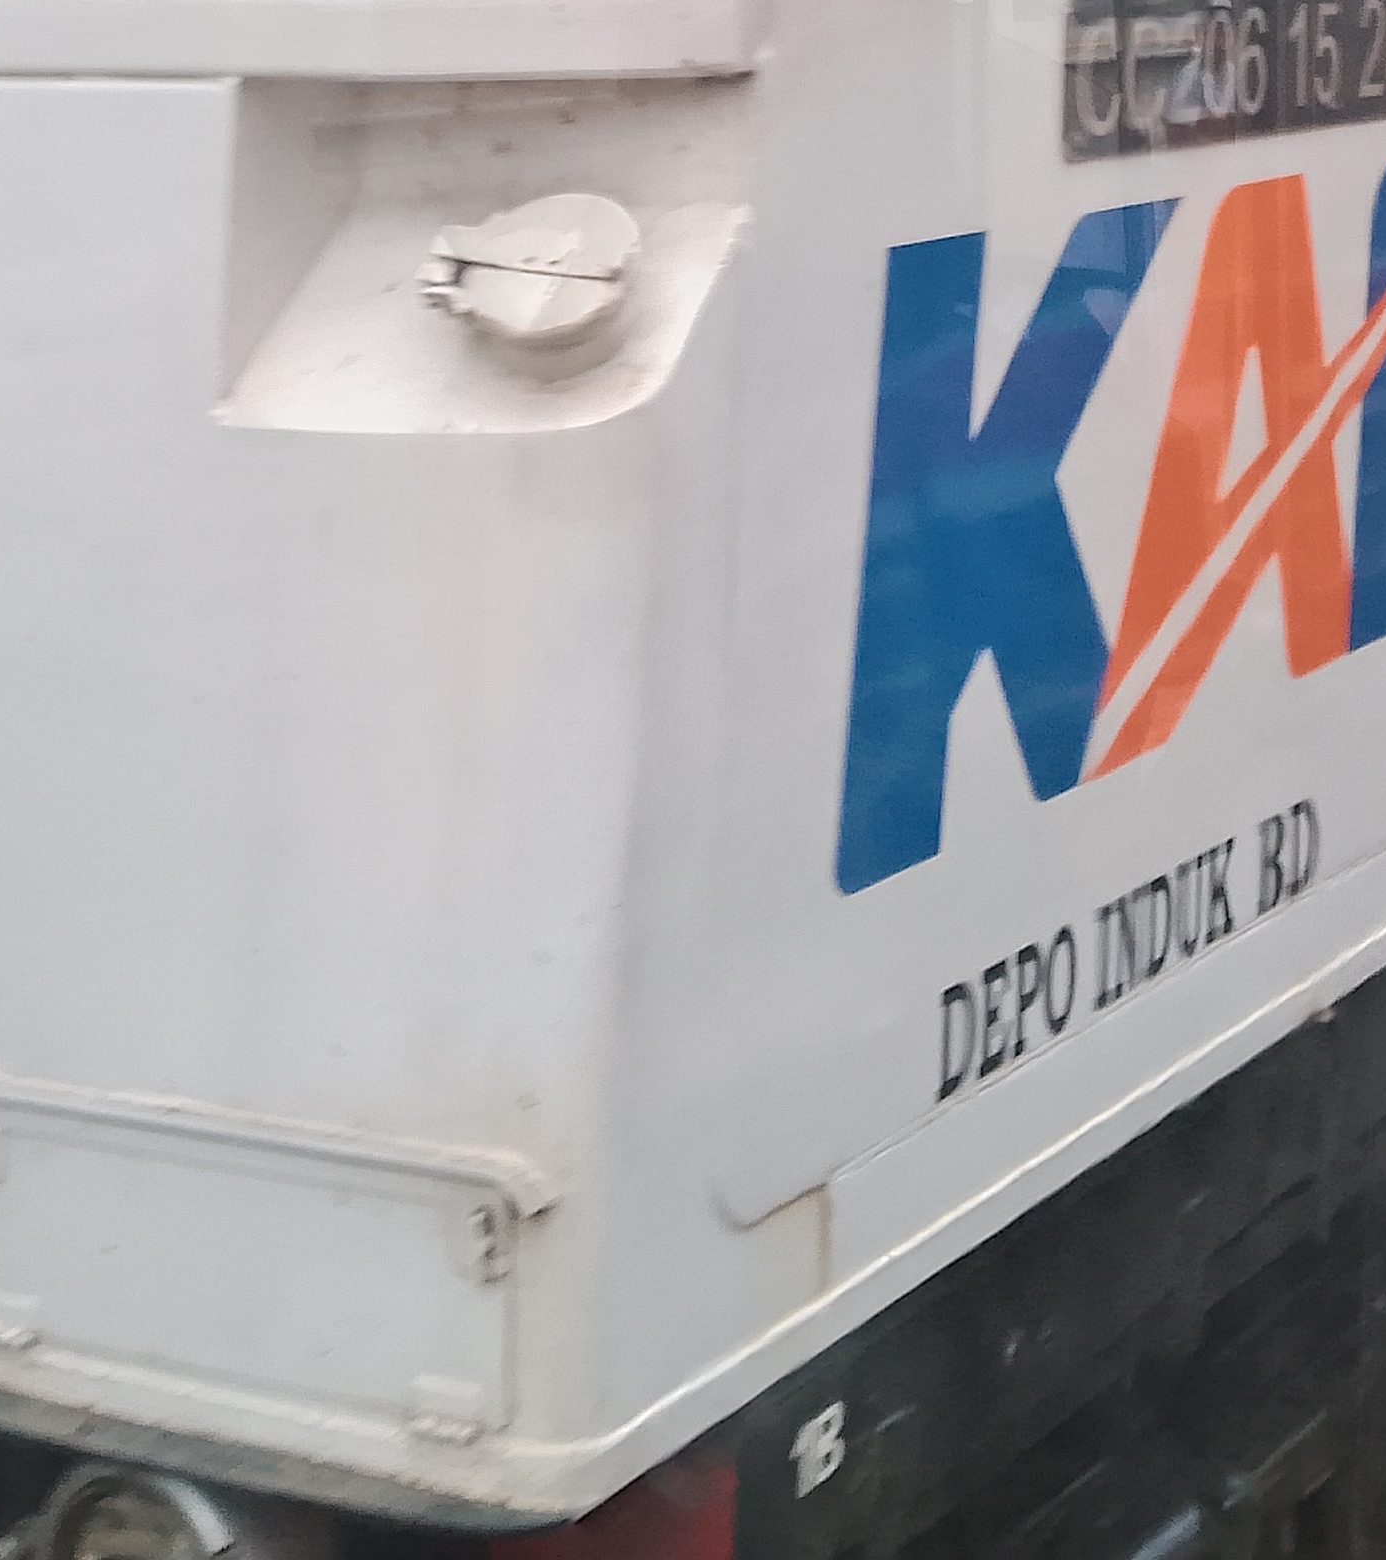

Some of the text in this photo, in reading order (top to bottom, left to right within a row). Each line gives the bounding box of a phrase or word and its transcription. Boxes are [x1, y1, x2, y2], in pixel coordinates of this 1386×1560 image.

[1286, 1, 1342, 111] 15
[938, 924, 1077, 1102] DEPO
[1092, 836, 1236, 1011] INDUK
